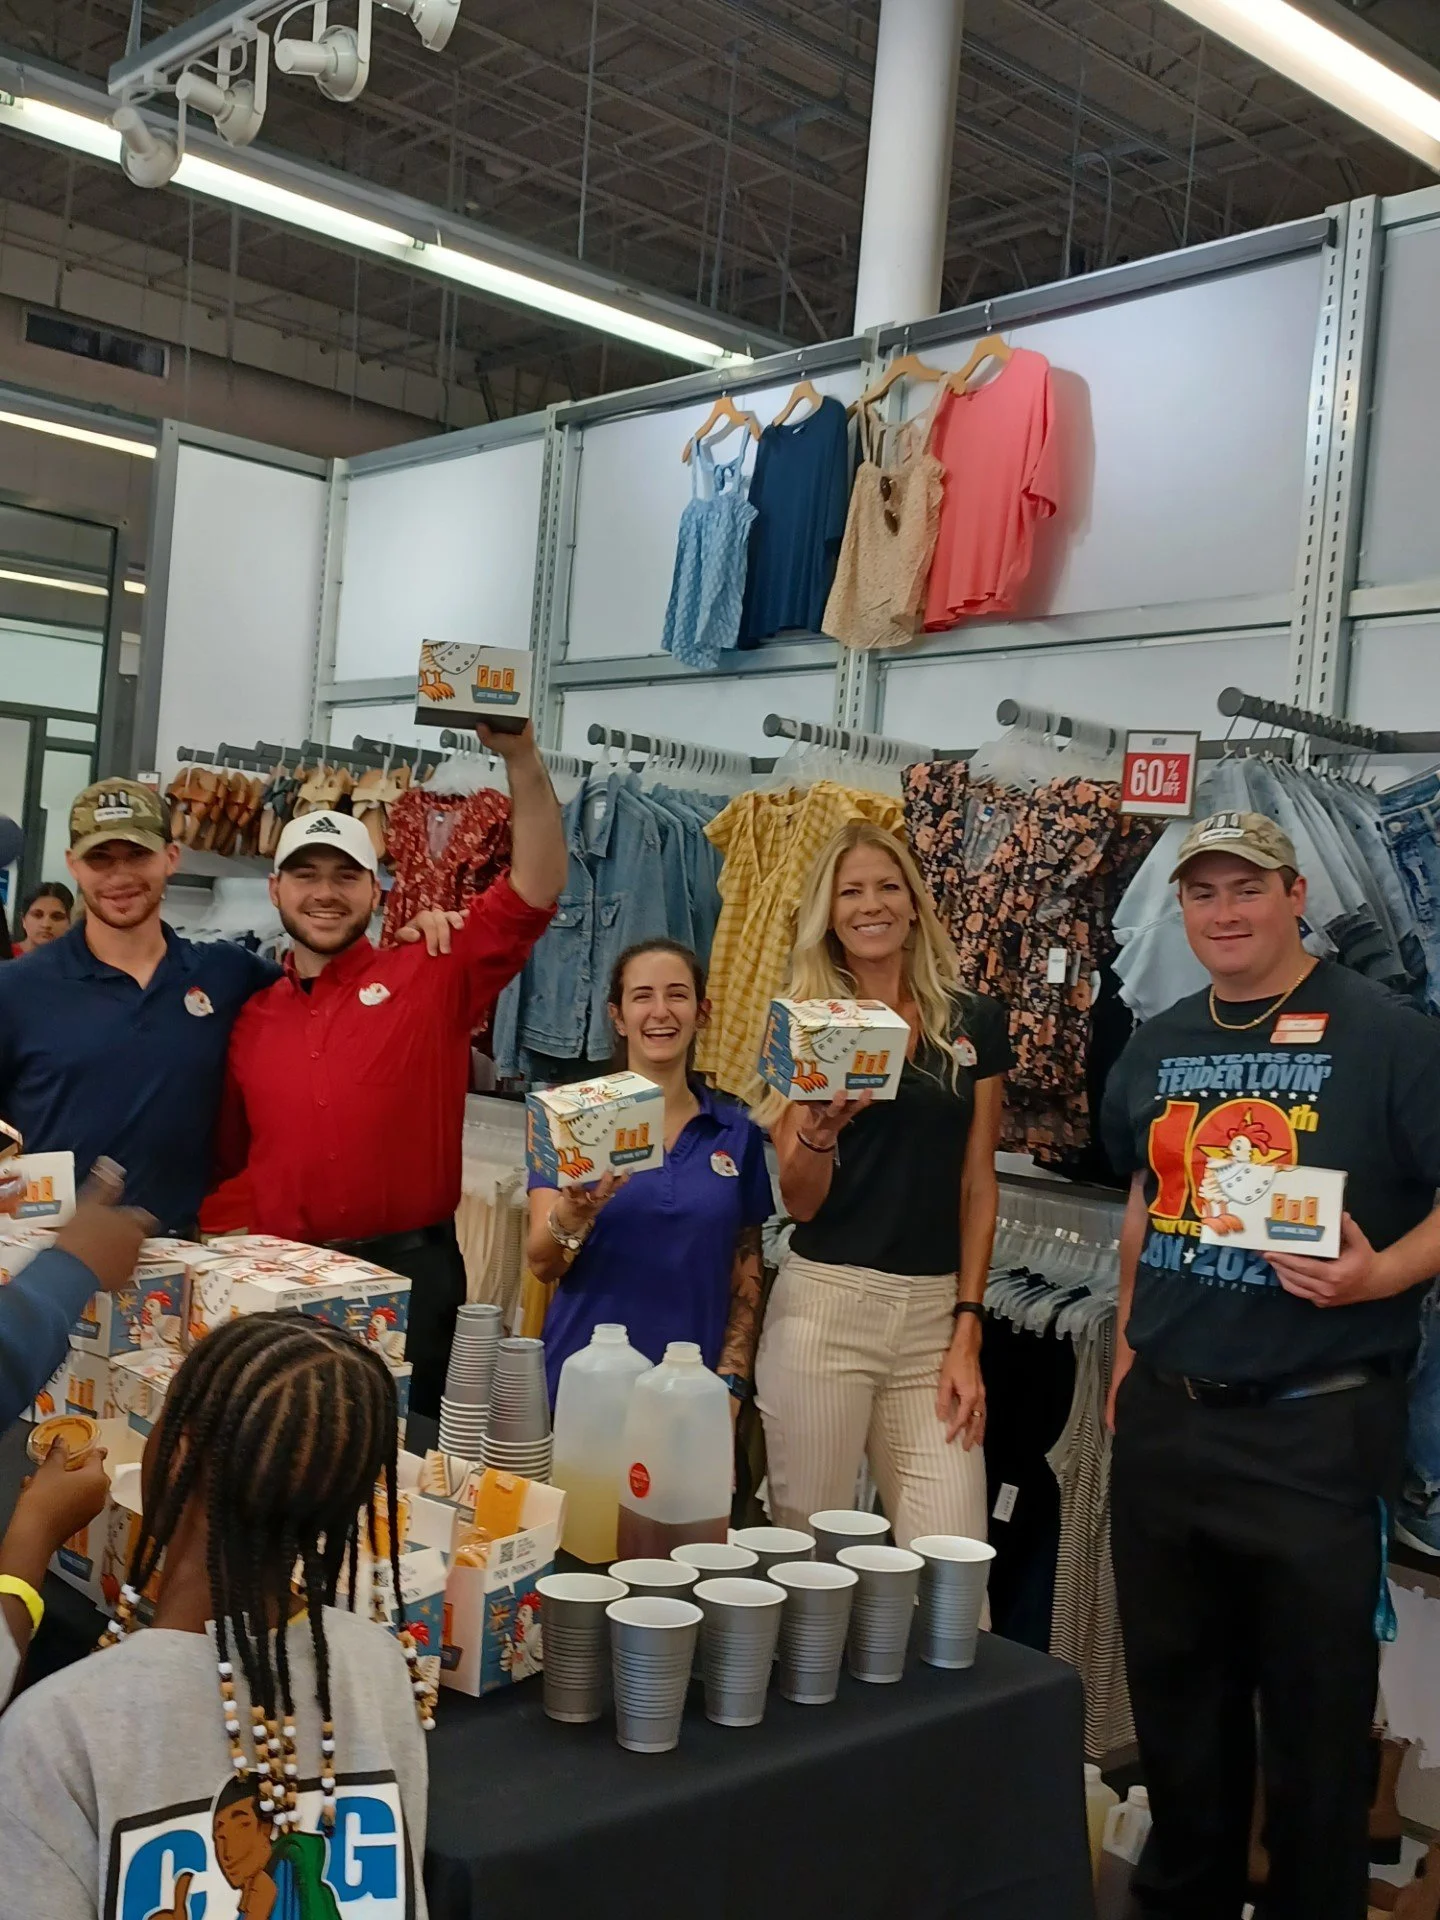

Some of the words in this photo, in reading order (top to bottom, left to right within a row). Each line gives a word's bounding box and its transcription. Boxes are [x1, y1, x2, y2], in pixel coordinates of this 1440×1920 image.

[1130, 758, 1181, 797] 60%
[305, 826, 341, 835] adidas
[1161, 1055, 1207, 1068] TEN
[1210, 1052, 1291, 1066] YEARS
[1294, 1052, 1333, 1065] OF
[1157, 1064, 1244, 1094] TENDER
[1246, 1063, 1332, 1093] LOVIN'
